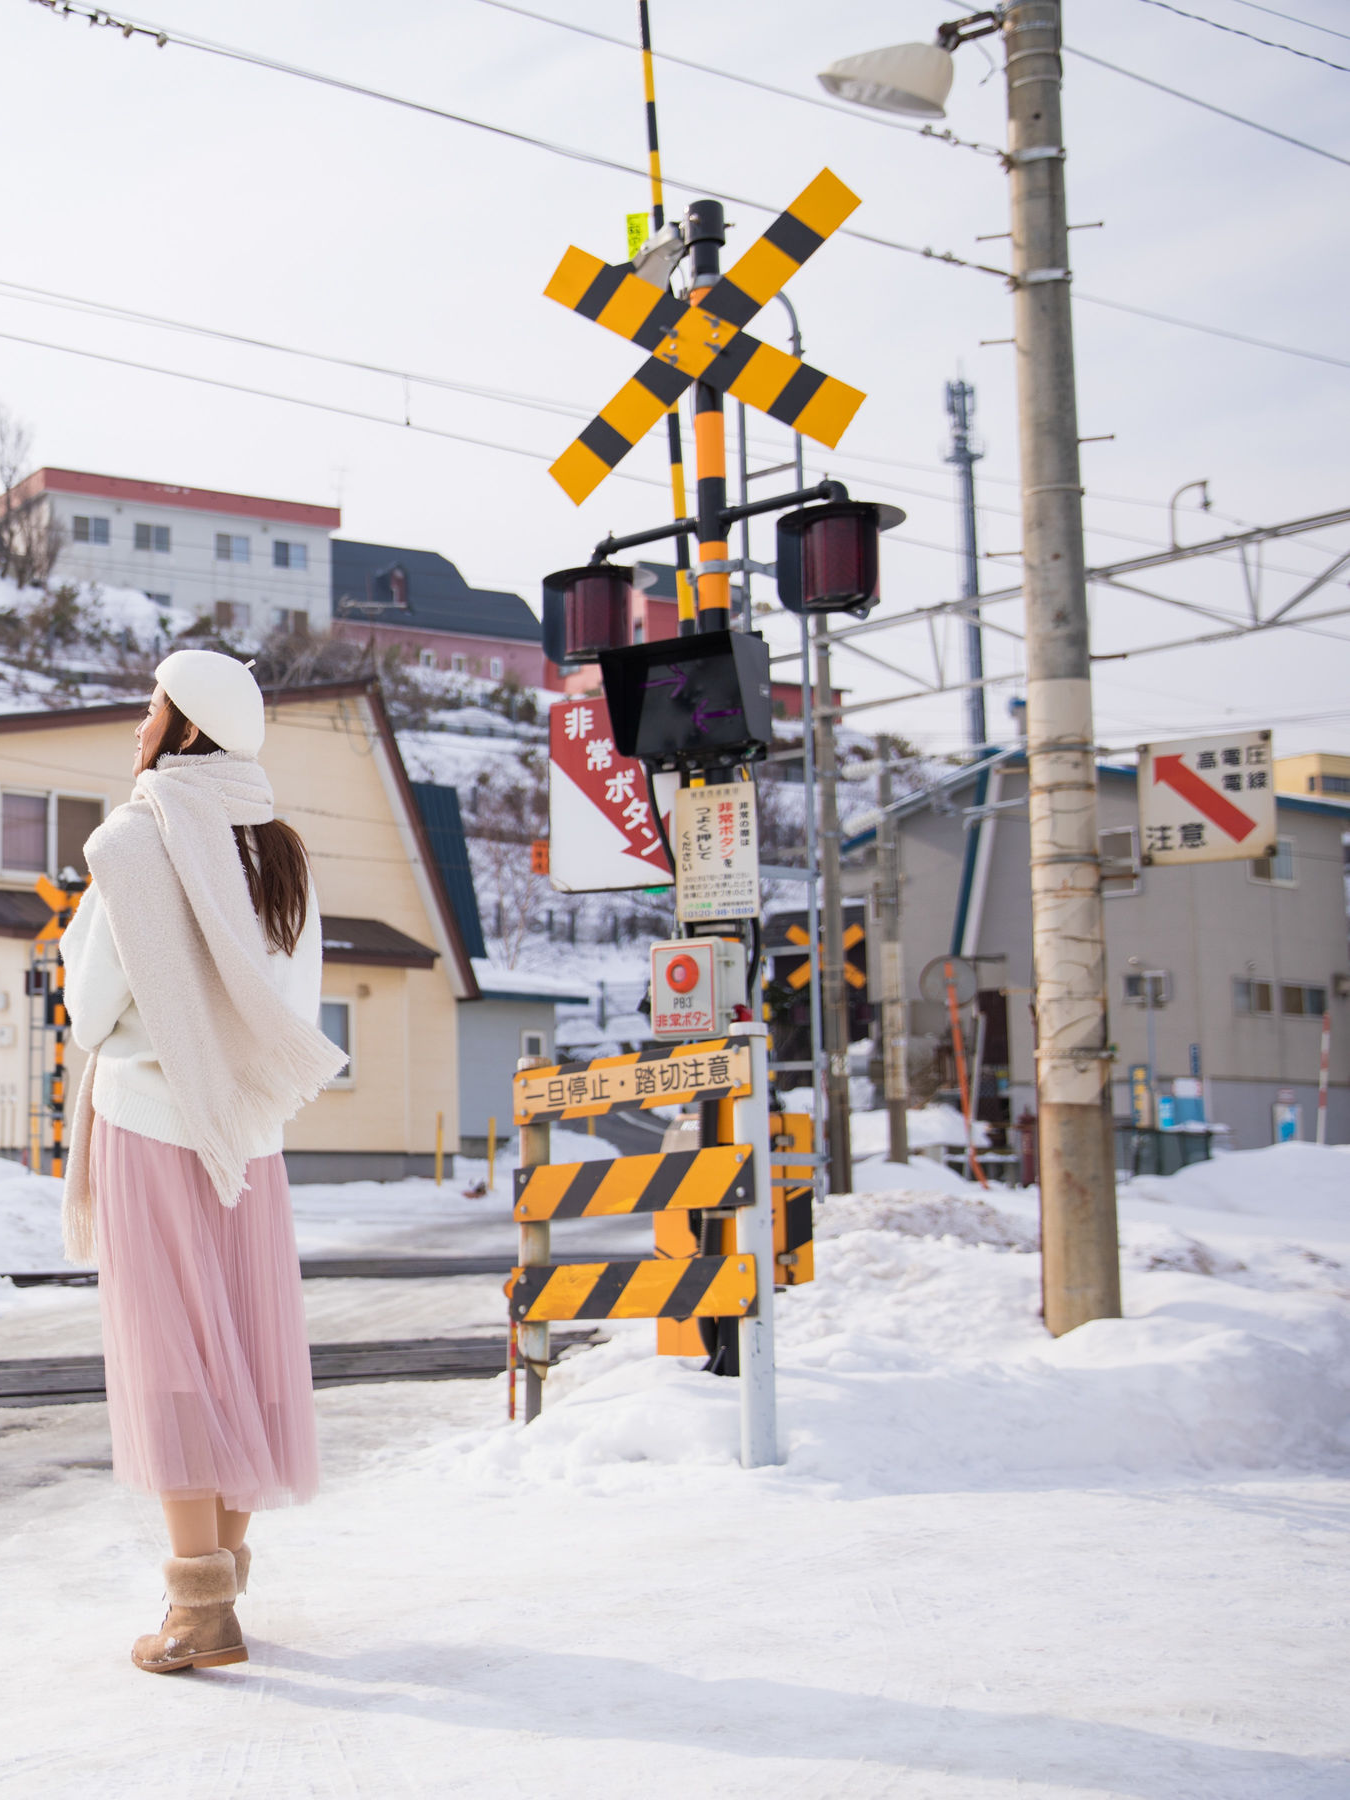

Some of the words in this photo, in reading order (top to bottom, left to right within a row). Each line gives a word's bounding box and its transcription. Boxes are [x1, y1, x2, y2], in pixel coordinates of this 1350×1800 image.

[1197, 744, 1266, 770] 高電圧
[564, 706, 663, 857] 非常ボタン
[1222, 771, 1267, 792] 電線
[718, 802, 735, 868] 非常ボタンを
[1146, 823, 1206, 851] 注意
